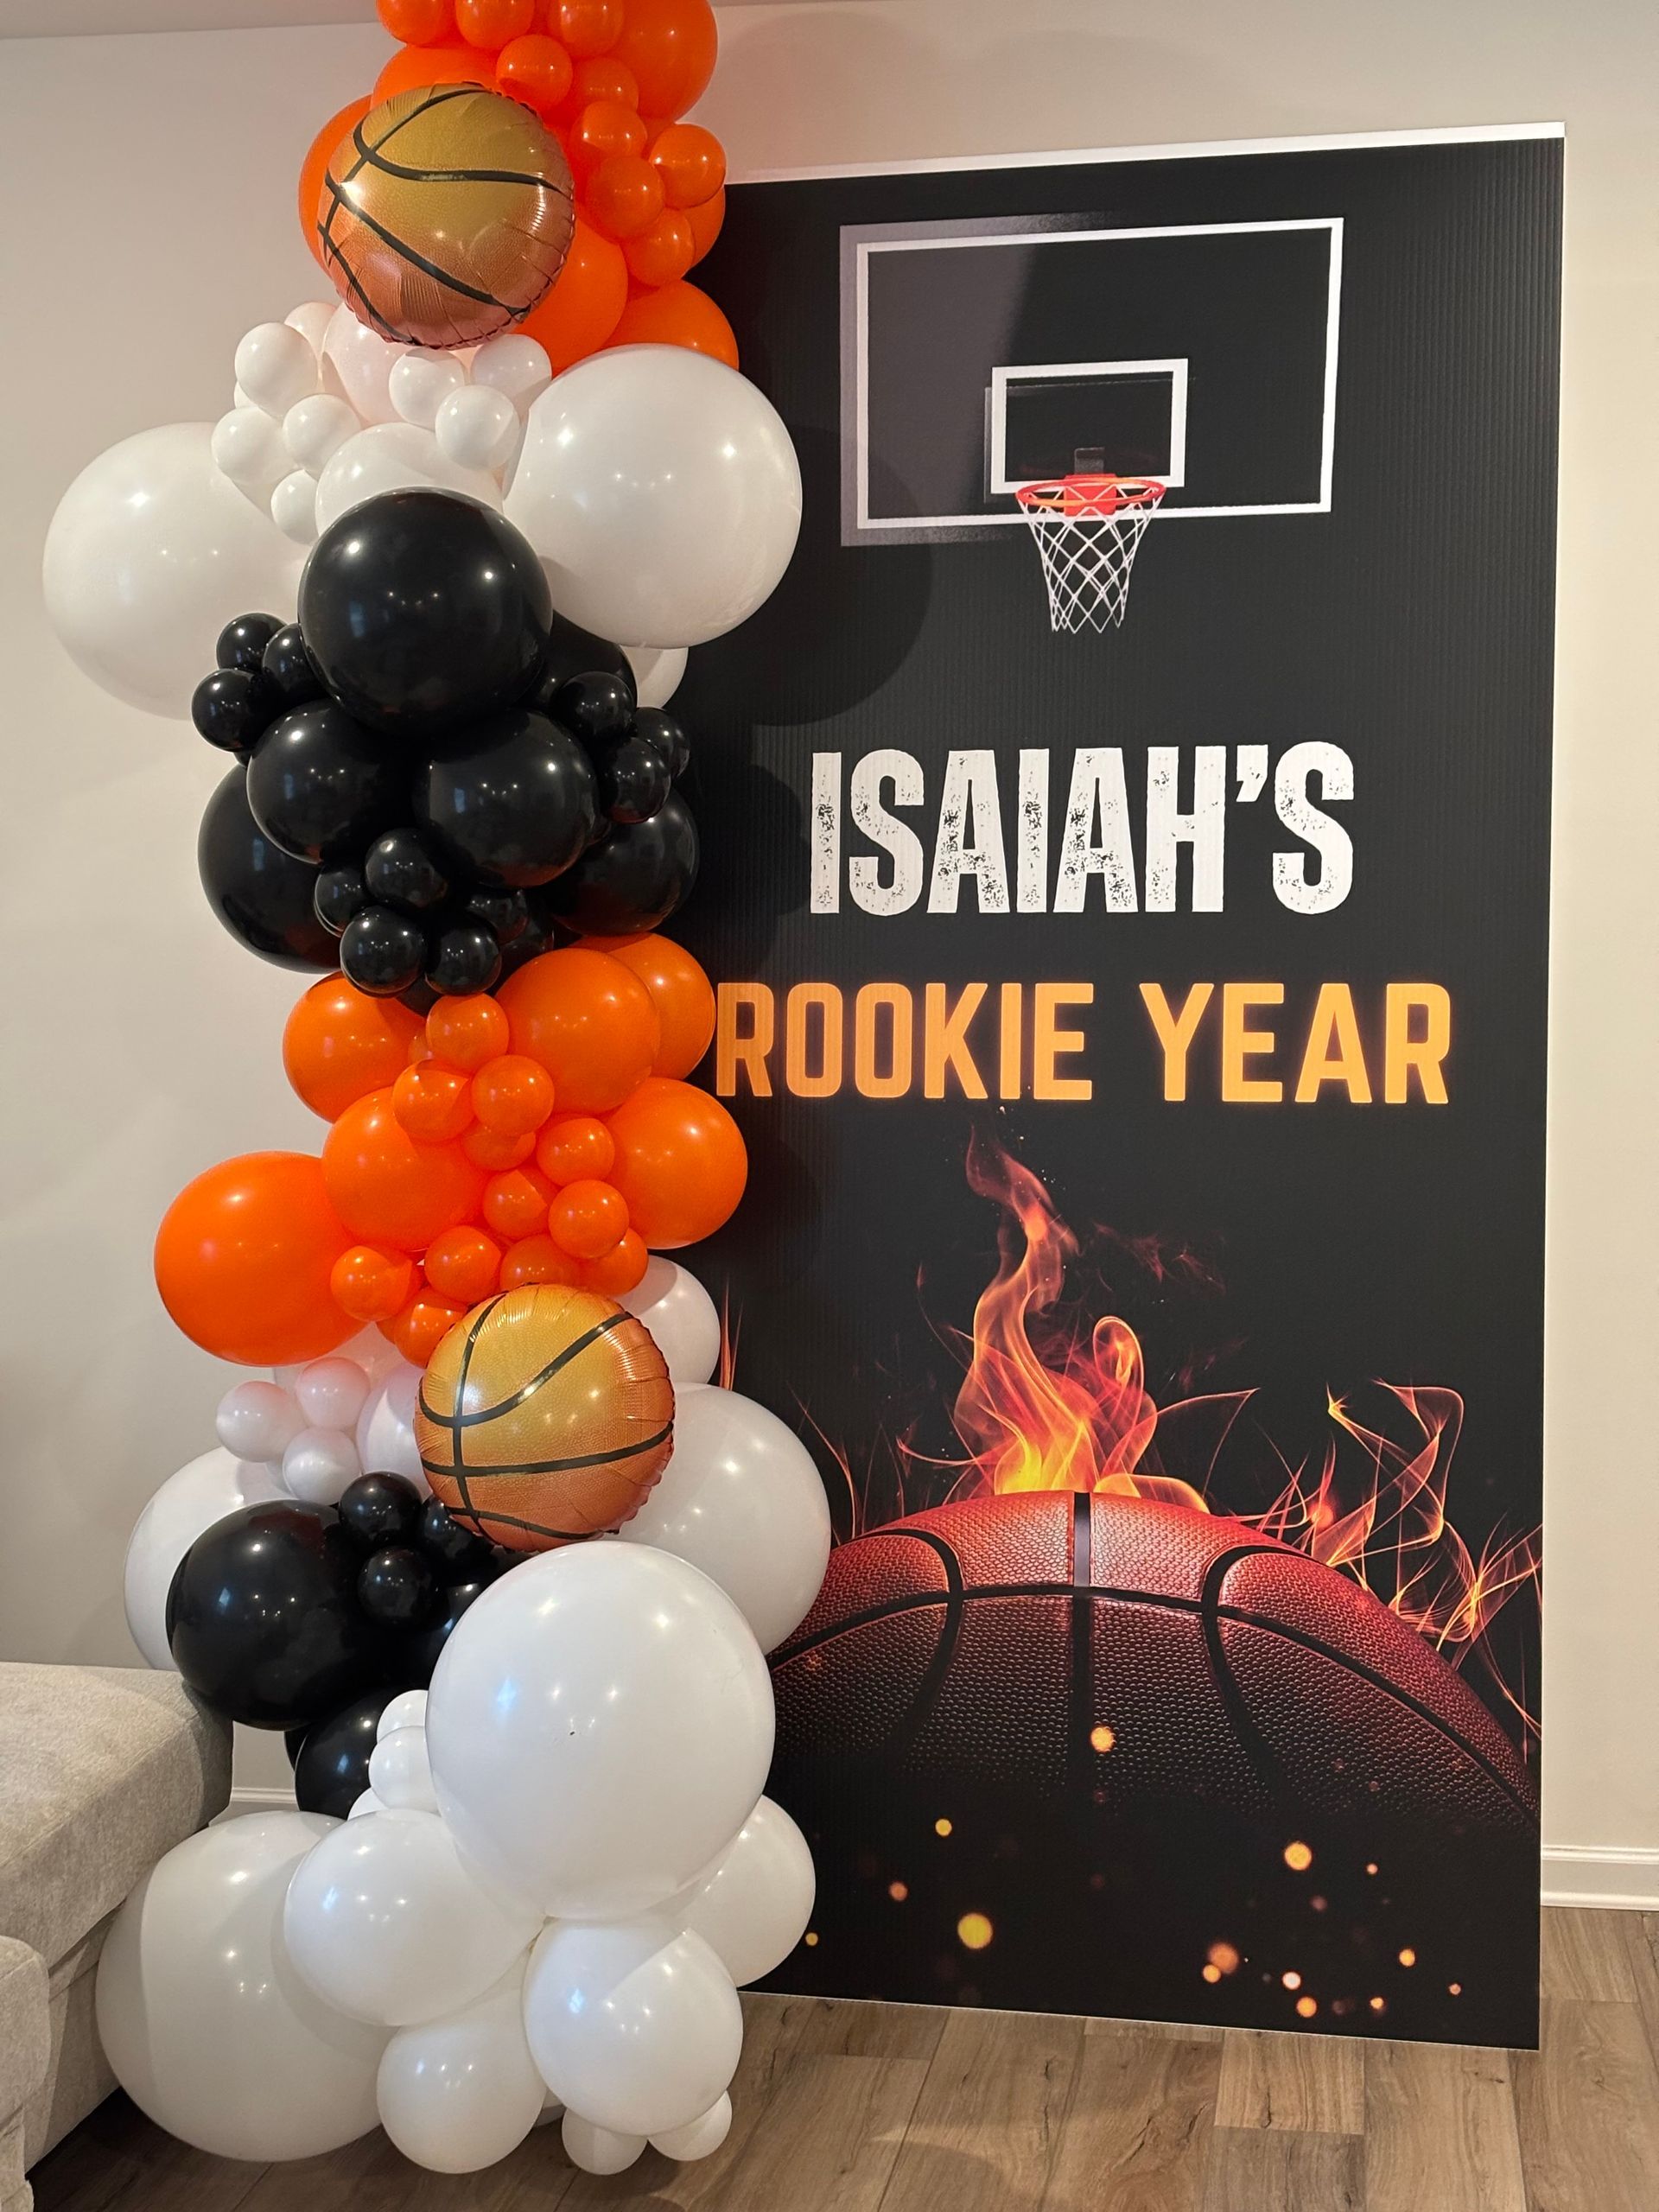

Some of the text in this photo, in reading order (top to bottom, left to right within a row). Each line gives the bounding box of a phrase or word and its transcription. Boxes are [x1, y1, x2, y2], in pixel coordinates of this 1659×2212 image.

[810, 741, 1355, 916] ISAIAH'S
[715, 982, 1452, 1105] ROOKIE YEAR
